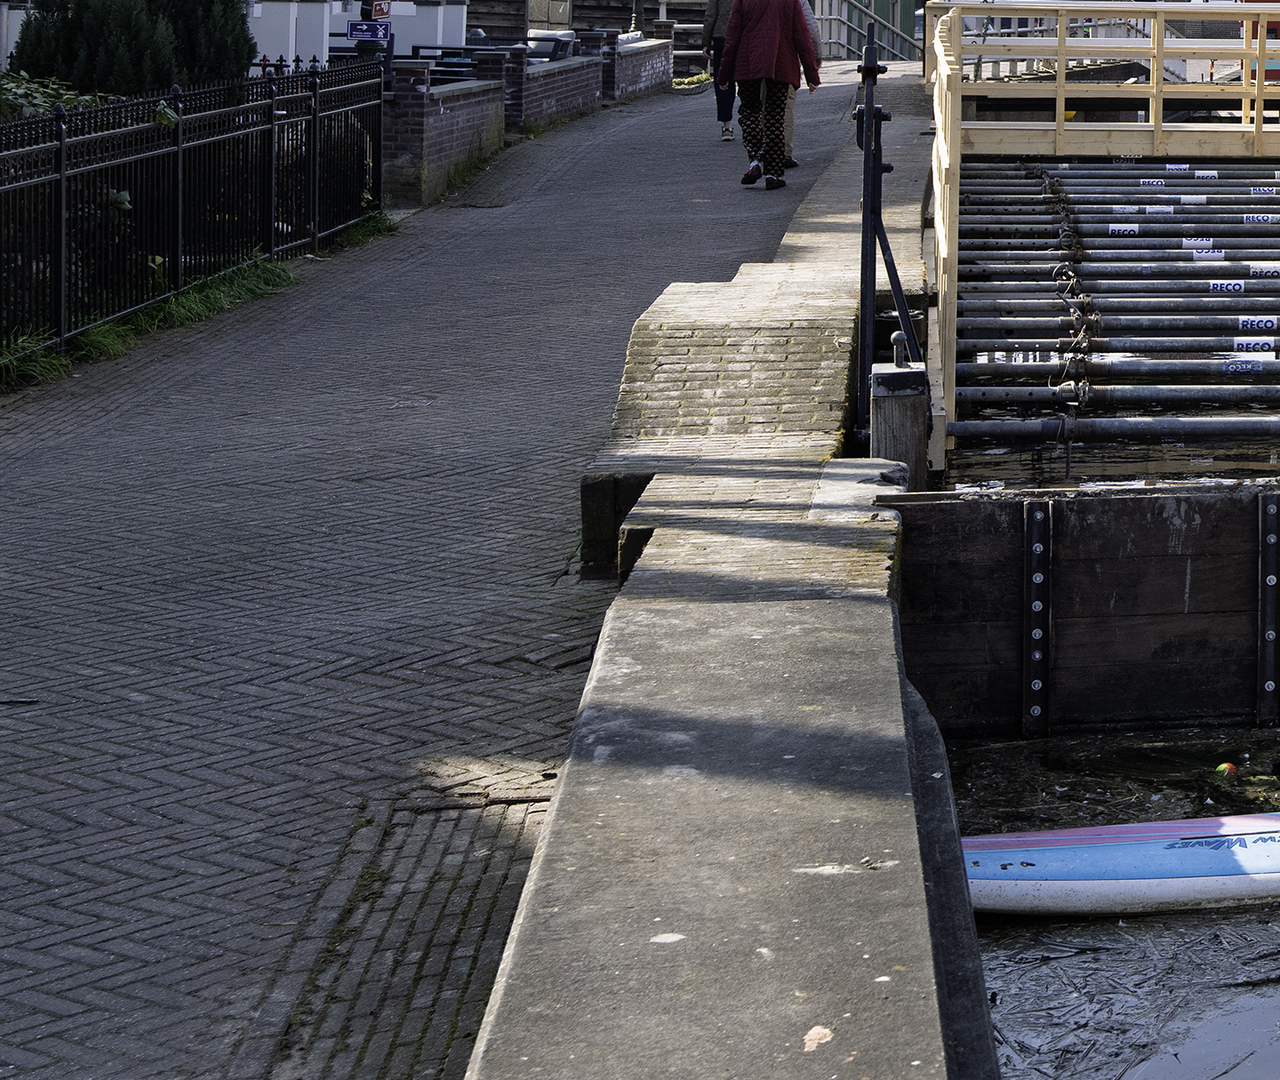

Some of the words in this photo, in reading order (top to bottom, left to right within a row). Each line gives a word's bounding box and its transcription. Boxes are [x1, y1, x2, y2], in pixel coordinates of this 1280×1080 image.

[1211, 282, 1243, 292] RECO
[1241, 319, 1275, 329] RECO
[1236, 342, 1272, 351] RECO
